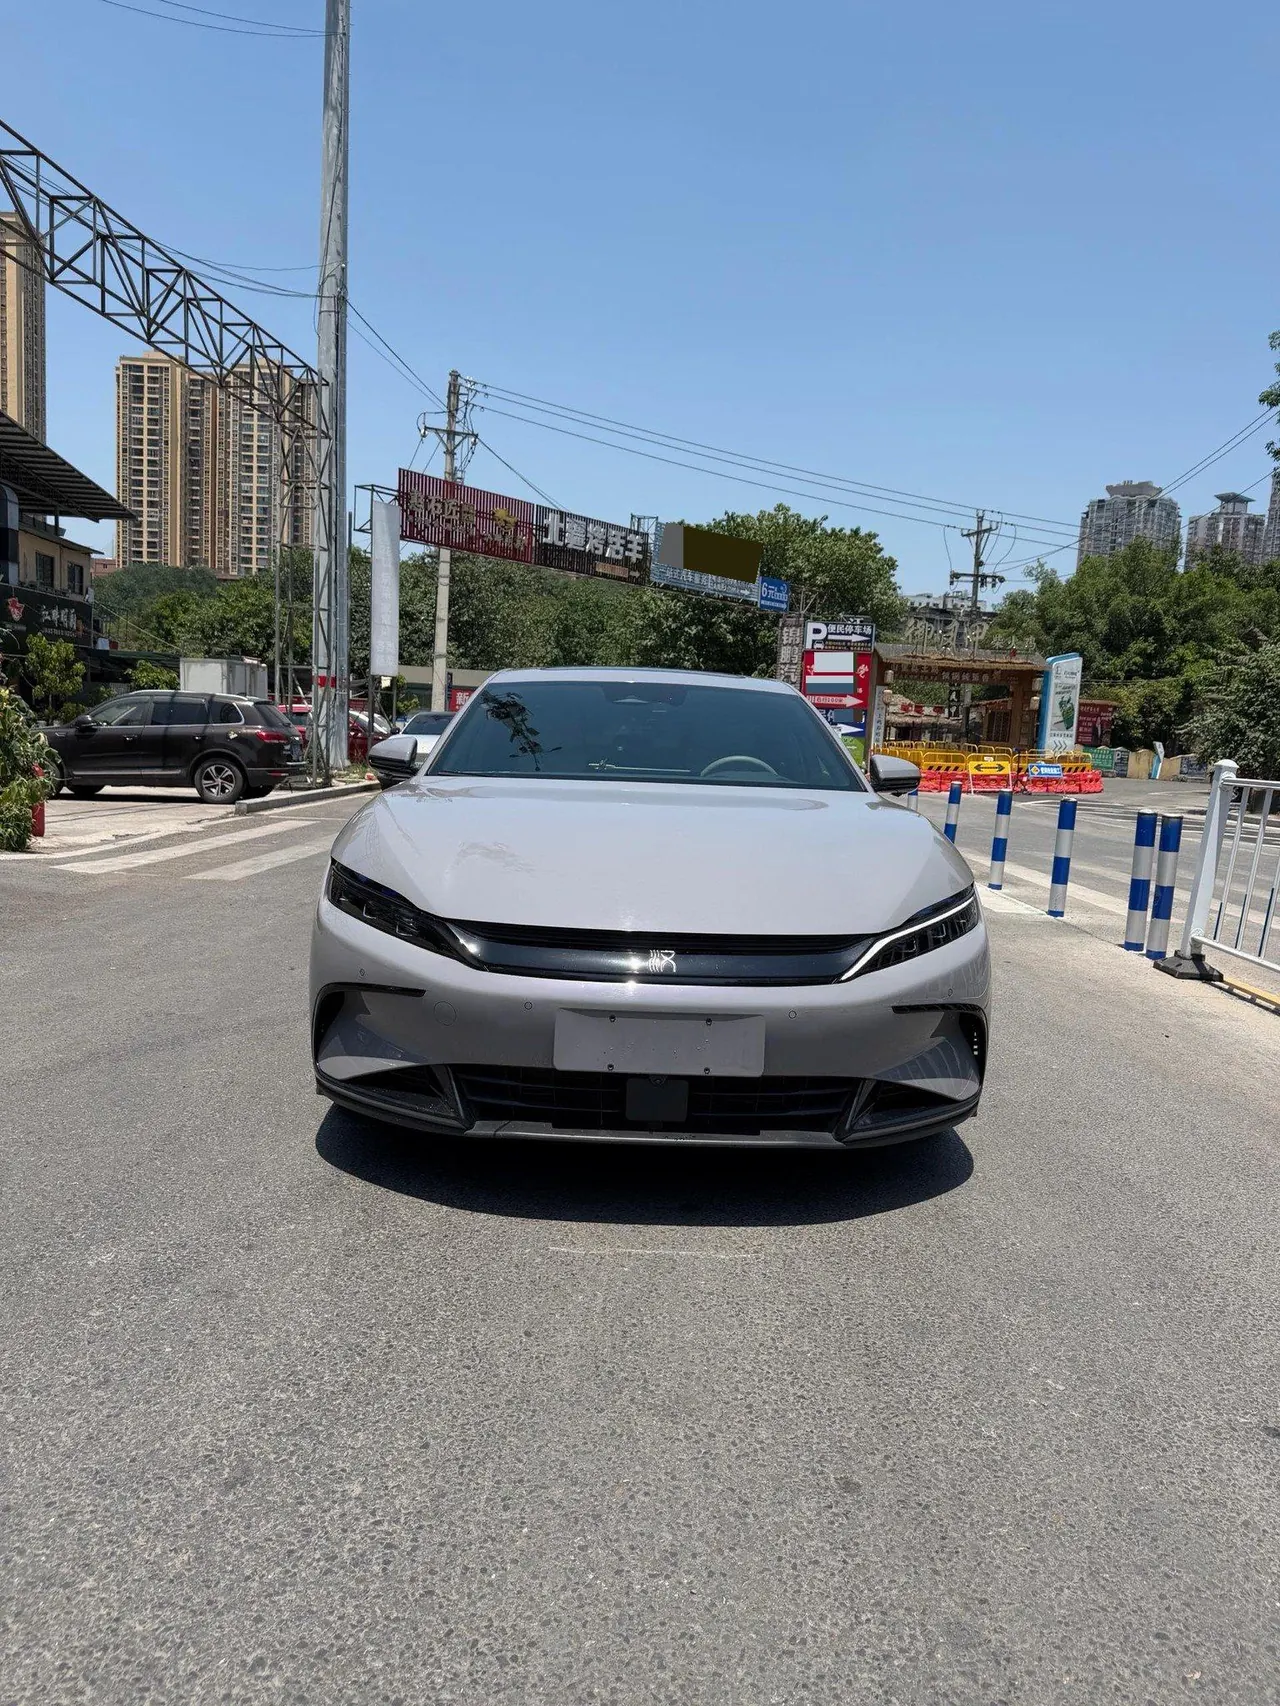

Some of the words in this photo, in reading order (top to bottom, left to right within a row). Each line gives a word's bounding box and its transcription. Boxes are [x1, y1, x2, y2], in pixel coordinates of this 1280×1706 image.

[805, 622, 827, 650] P
[827, 623, 872, 635] 便民停车场
